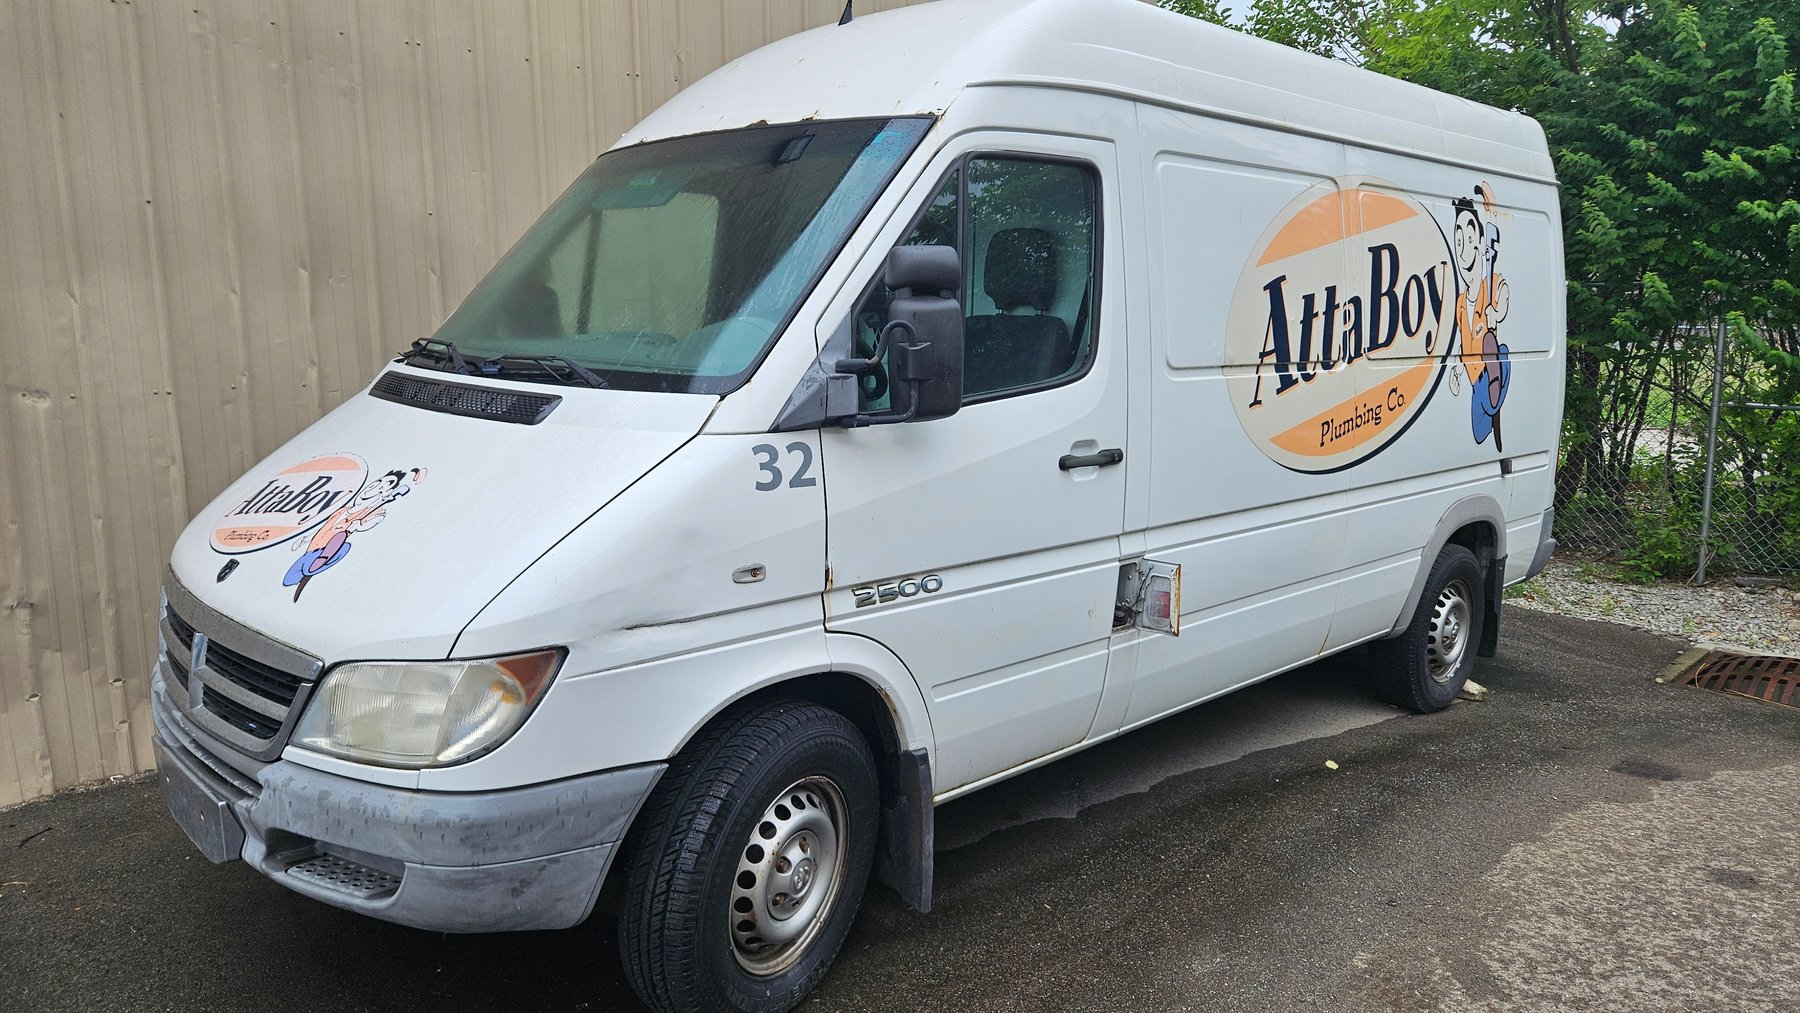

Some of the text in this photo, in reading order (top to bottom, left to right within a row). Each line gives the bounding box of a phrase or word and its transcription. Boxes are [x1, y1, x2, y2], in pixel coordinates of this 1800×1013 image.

[1249, 243, 1448, 408] AttaBoy
[1320, 402, 1382, 448] Plumbing
[752, 441, 816, 491] 32
[224, 475, 353, 525] AttaBoy
[852, 574, 943, 608] 2500
